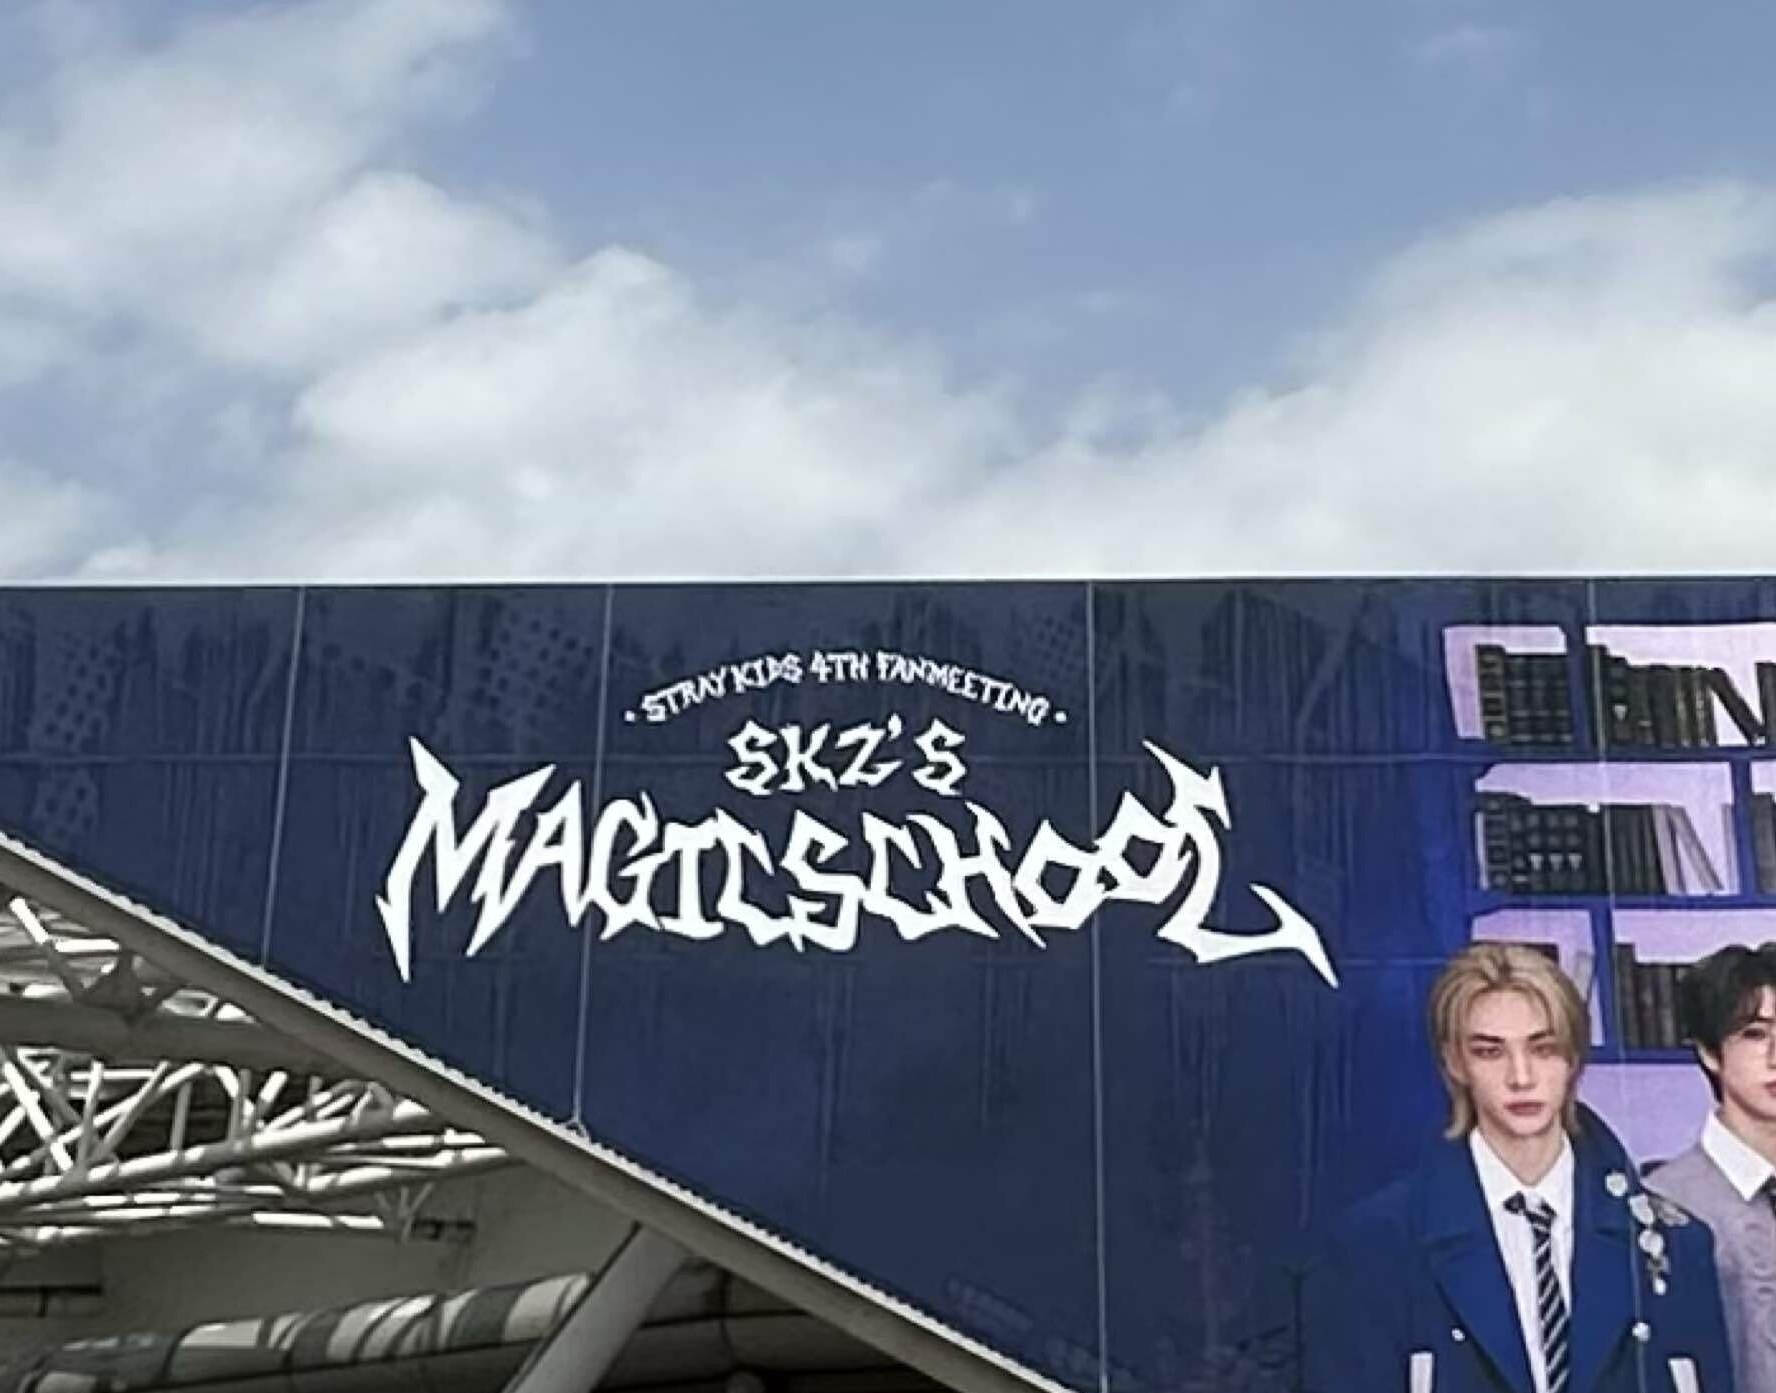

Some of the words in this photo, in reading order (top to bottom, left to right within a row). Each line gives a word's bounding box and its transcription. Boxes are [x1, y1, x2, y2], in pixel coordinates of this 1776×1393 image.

[641, 665, 727, 723] STRAY
[730, 652, 802, 694] KIDS
[810, 650, 869, 682] 4TH
[877, 650, 1051, 726] FANMEETING
